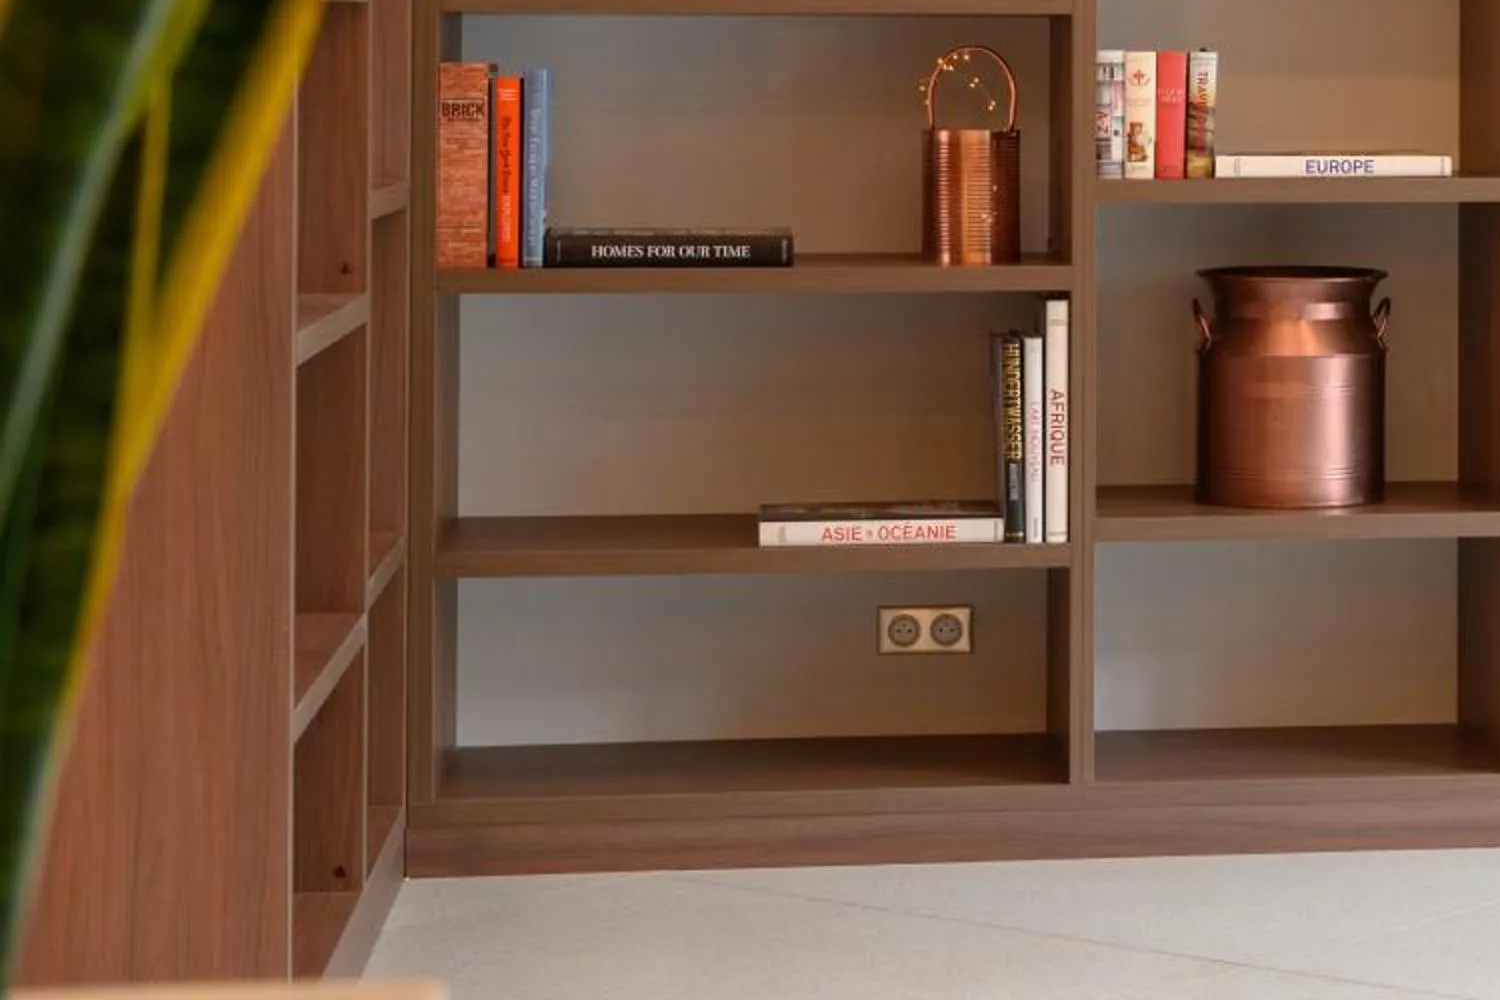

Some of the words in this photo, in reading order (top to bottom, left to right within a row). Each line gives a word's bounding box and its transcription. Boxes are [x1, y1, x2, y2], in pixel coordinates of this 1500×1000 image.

[441, 101, 485, 117] BRICK
[1305, 159, 1375, 174] EUROPE
[591, 245, 644, 259] HOMES
[648, 244, 676, 258] FOR
[679, 244, 711, 258] OUR
[714, 244, 750, 258] TIME
[1005, 343, 1022, 461] HUNDERTWASSER
[1050, 388, 1065, 466] AFRIQUE
[821, 525, 862, 541] ASIE
[879, 520, 957, 540] OCÉANIE
